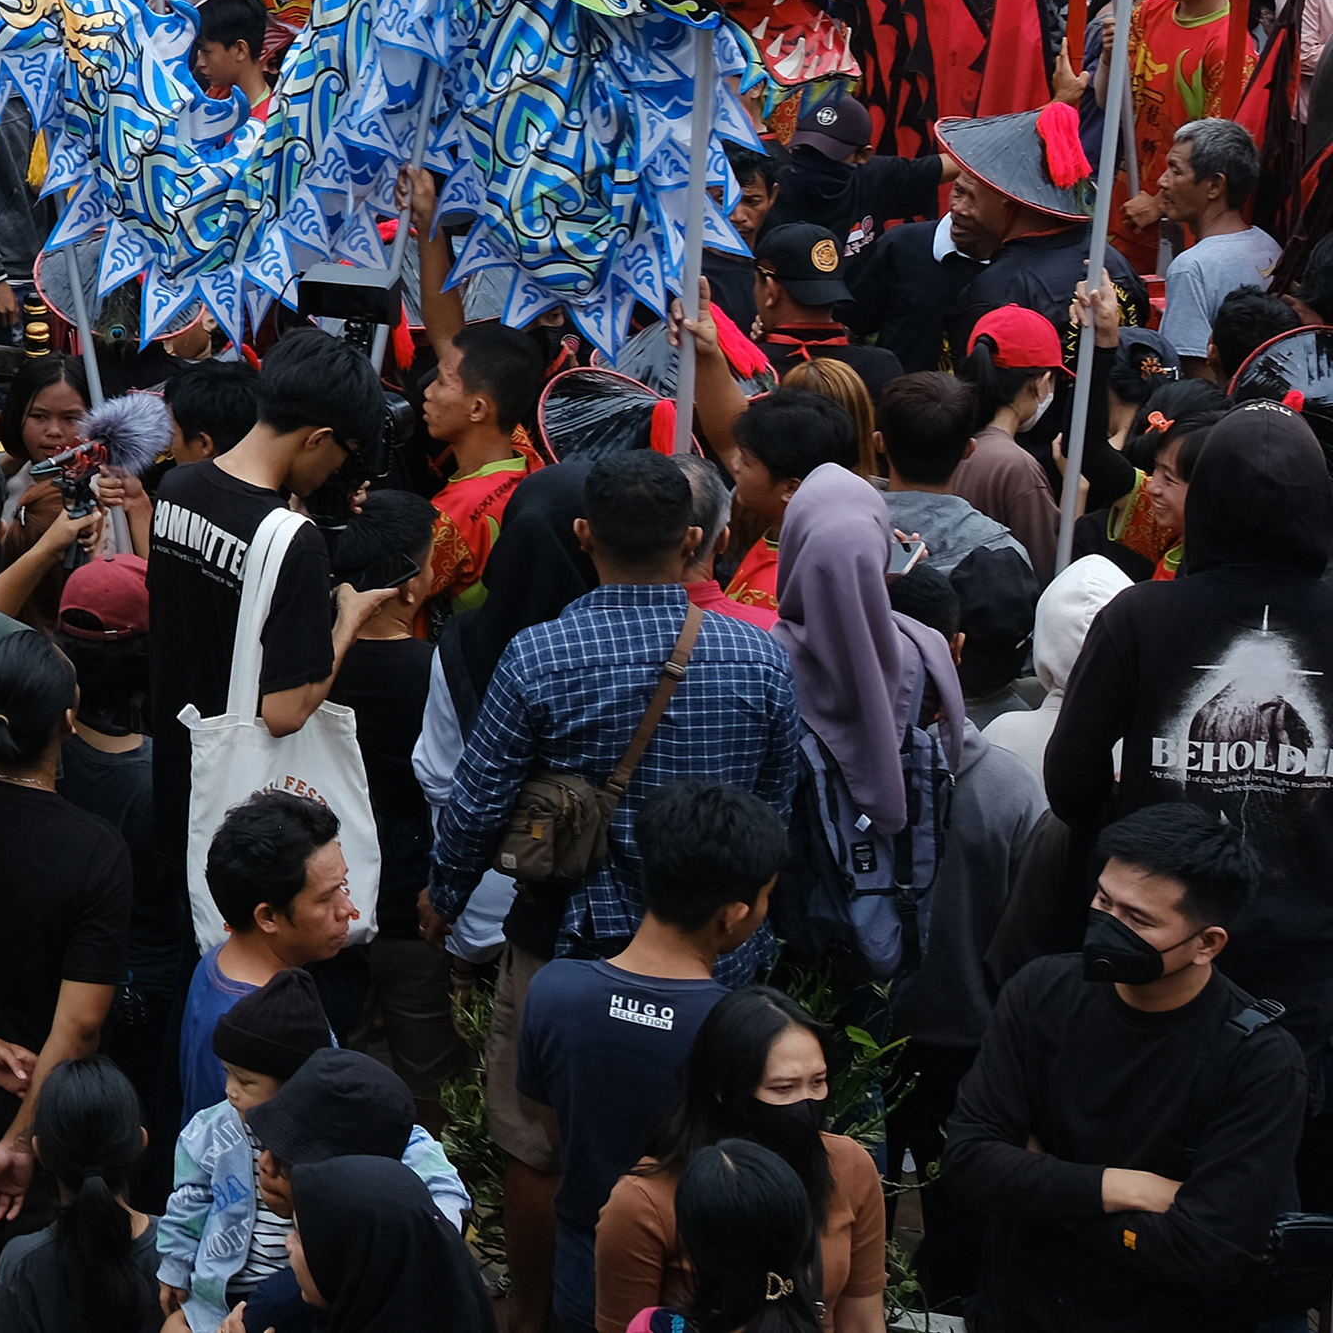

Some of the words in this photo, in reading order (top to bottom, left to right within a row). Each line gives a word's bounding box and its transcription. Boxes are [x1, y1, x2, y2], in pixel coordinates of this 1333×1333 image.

[1151, 736, 1333, 778] BEHOLDE
[610, 994, 675, 1021] HUGO
[612, 1007, 670, 1029] SELECTION
